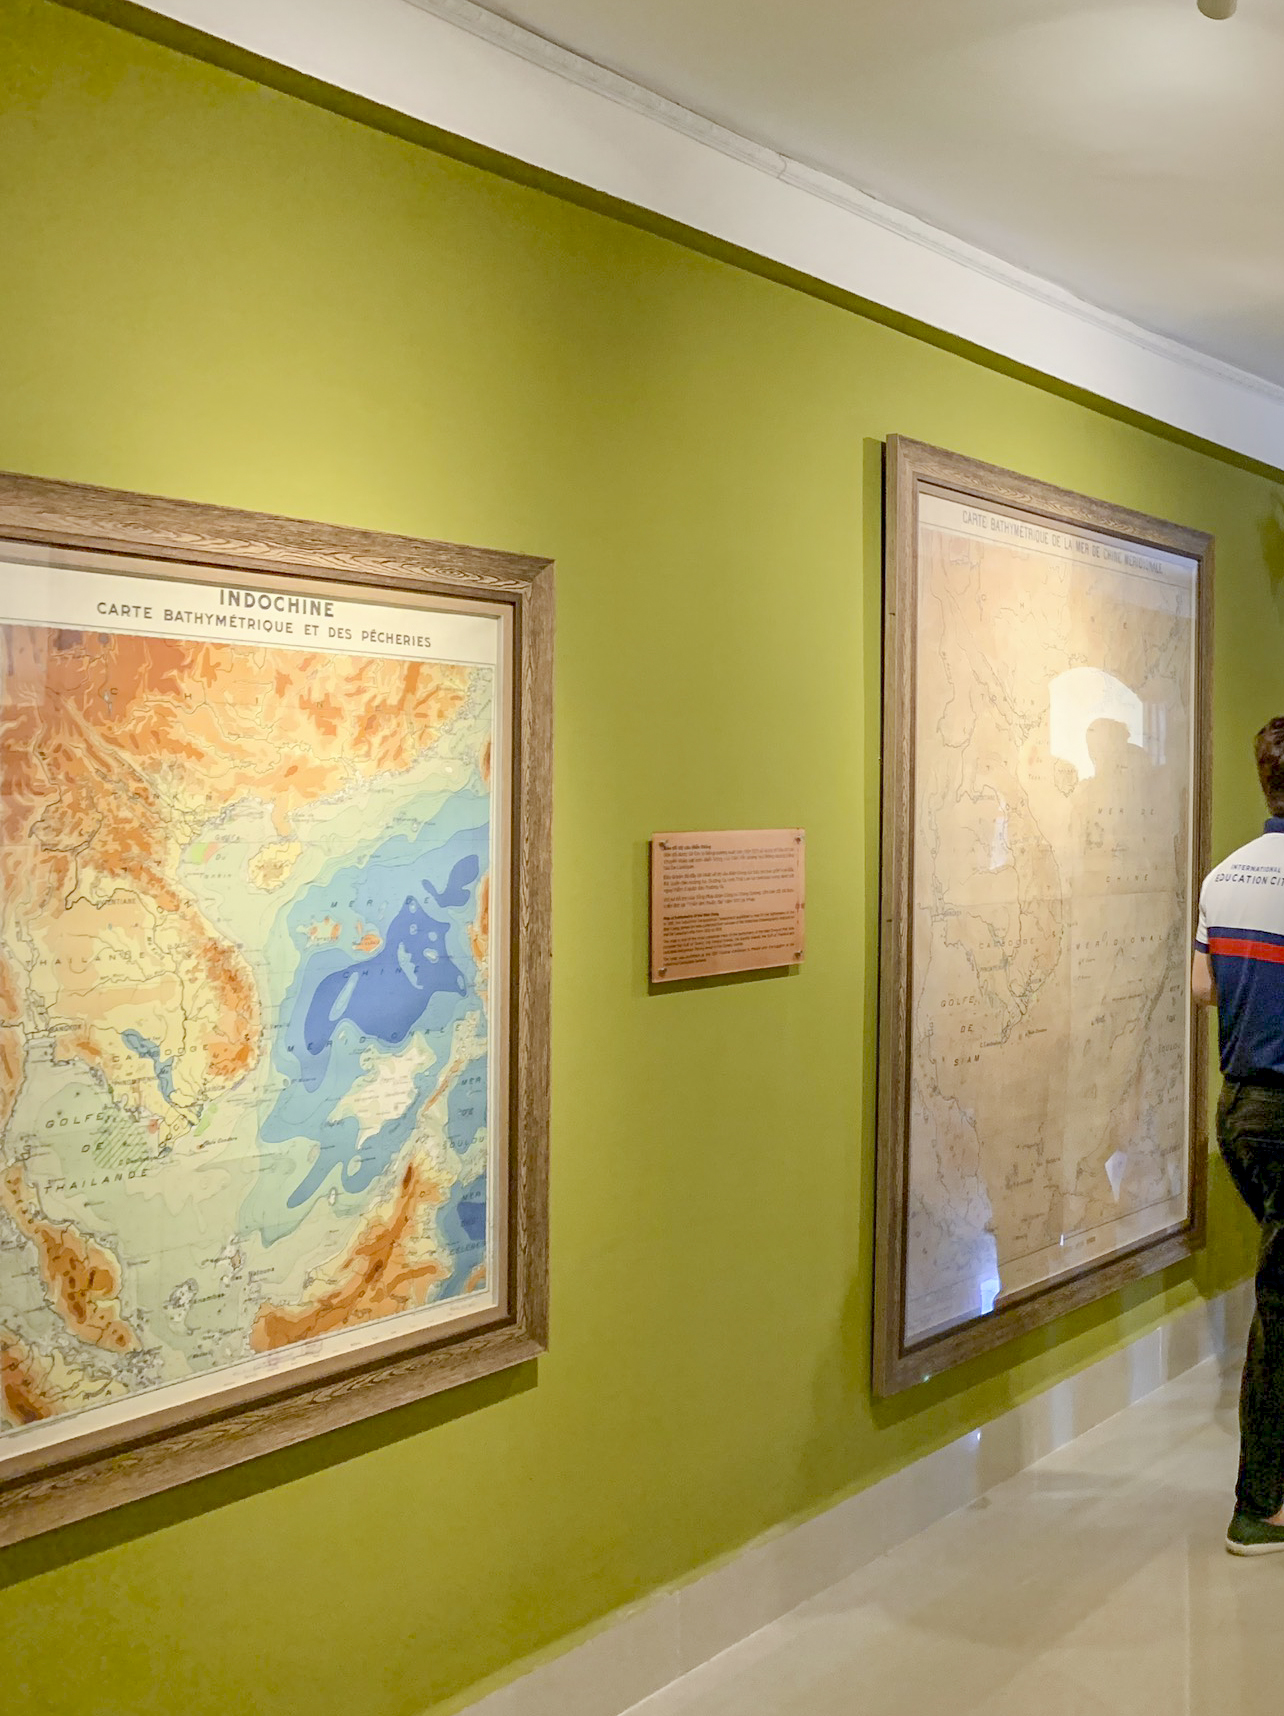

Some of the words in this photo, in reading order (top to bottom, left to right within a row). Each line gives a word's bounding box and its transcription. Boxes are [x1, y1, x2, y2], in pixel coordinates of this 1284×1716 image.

[962, 510, 988, 529] CARTE
[1051, 534, 1061, 548] DE
[1075, 540, 1090, 555] MER
[219, 589, 335, 618] INDOCHINE
[96, 601, 153, 620] CARTE
[163, 608, 294, 634] BATHYMÉTRIQUE
[303, 623, 320, 637] ET
[328, 626, 353, 641] DES
[360, 628, 432, 649] PÊCHERIES
[1215, 873, 1268, 885] EDUCATION
[1231, 864, 1281, 873] INTERNATIONAL
[45, 1111, 104, 1129] GOLFE
[81, 1142, 104, 1153] DE
[44, 1168, 149, 1194] THAILANDE
